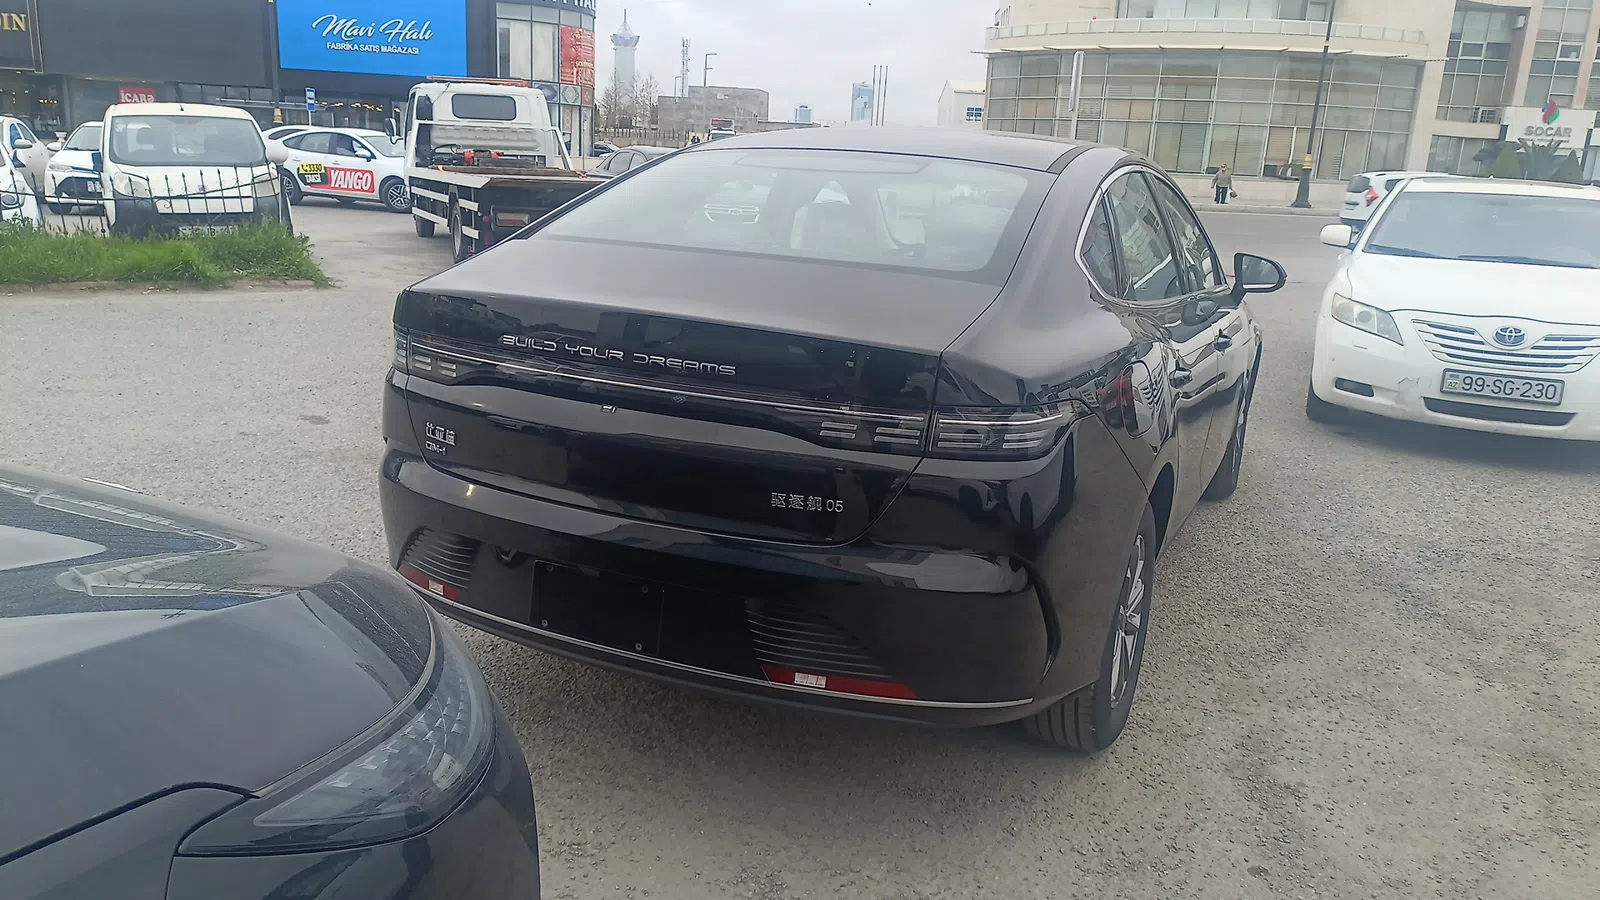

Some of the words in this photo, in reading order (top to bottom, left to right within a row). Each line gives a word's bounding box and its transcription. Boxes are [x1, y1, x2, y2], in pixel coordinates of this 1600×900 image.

[0, 12, 26, 31] IN
[312, 14, 376, 40] Mavi
[379, 18, 434, 43] Halı
[326, 41, 359, 52] FABRİKA
[359, 44, 380, 54] SATIŞ
[381, 45, 419, 55] MAĞAZASI
[1524, 125, 1572, 138] SOCAR
[308, 163, 323, 173] 3330
[330, 169, 373, 191] YANGO
[502, 334, 557, 352] BUILD
[565, 342, 625, 362] YOUR
[632, 352, 737, 376] DREAMS
[1461, 375, 1557, 399] 99-SG-230
[771, 492, 822, 511] 驱逐舰
[826, 499, 843, 512] 05
